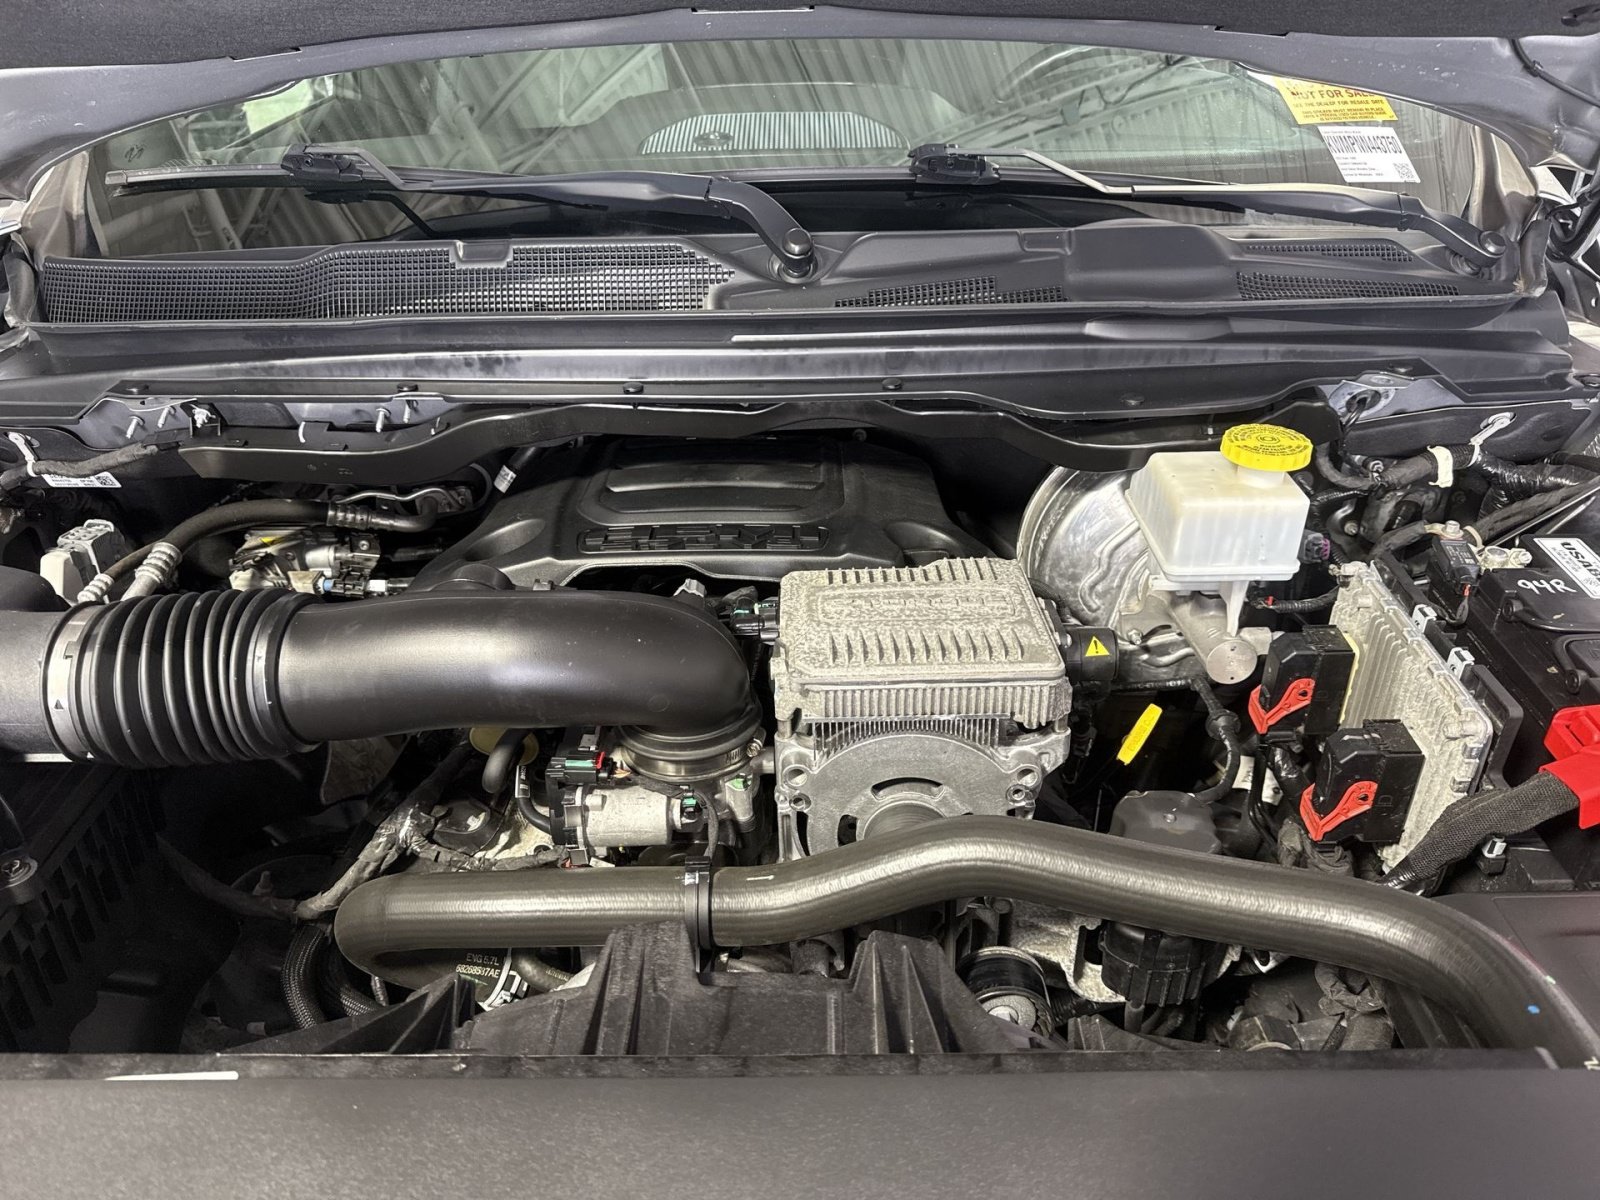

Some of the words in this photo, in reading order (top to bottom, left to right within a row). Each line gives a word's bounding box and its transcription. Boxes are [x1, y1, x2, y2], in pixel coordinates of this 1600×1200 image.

[1319, 89, 1342, 99] FOR
[1517, 578, 1577, 595] 94R
[466, 952, 482, 963] ENG
